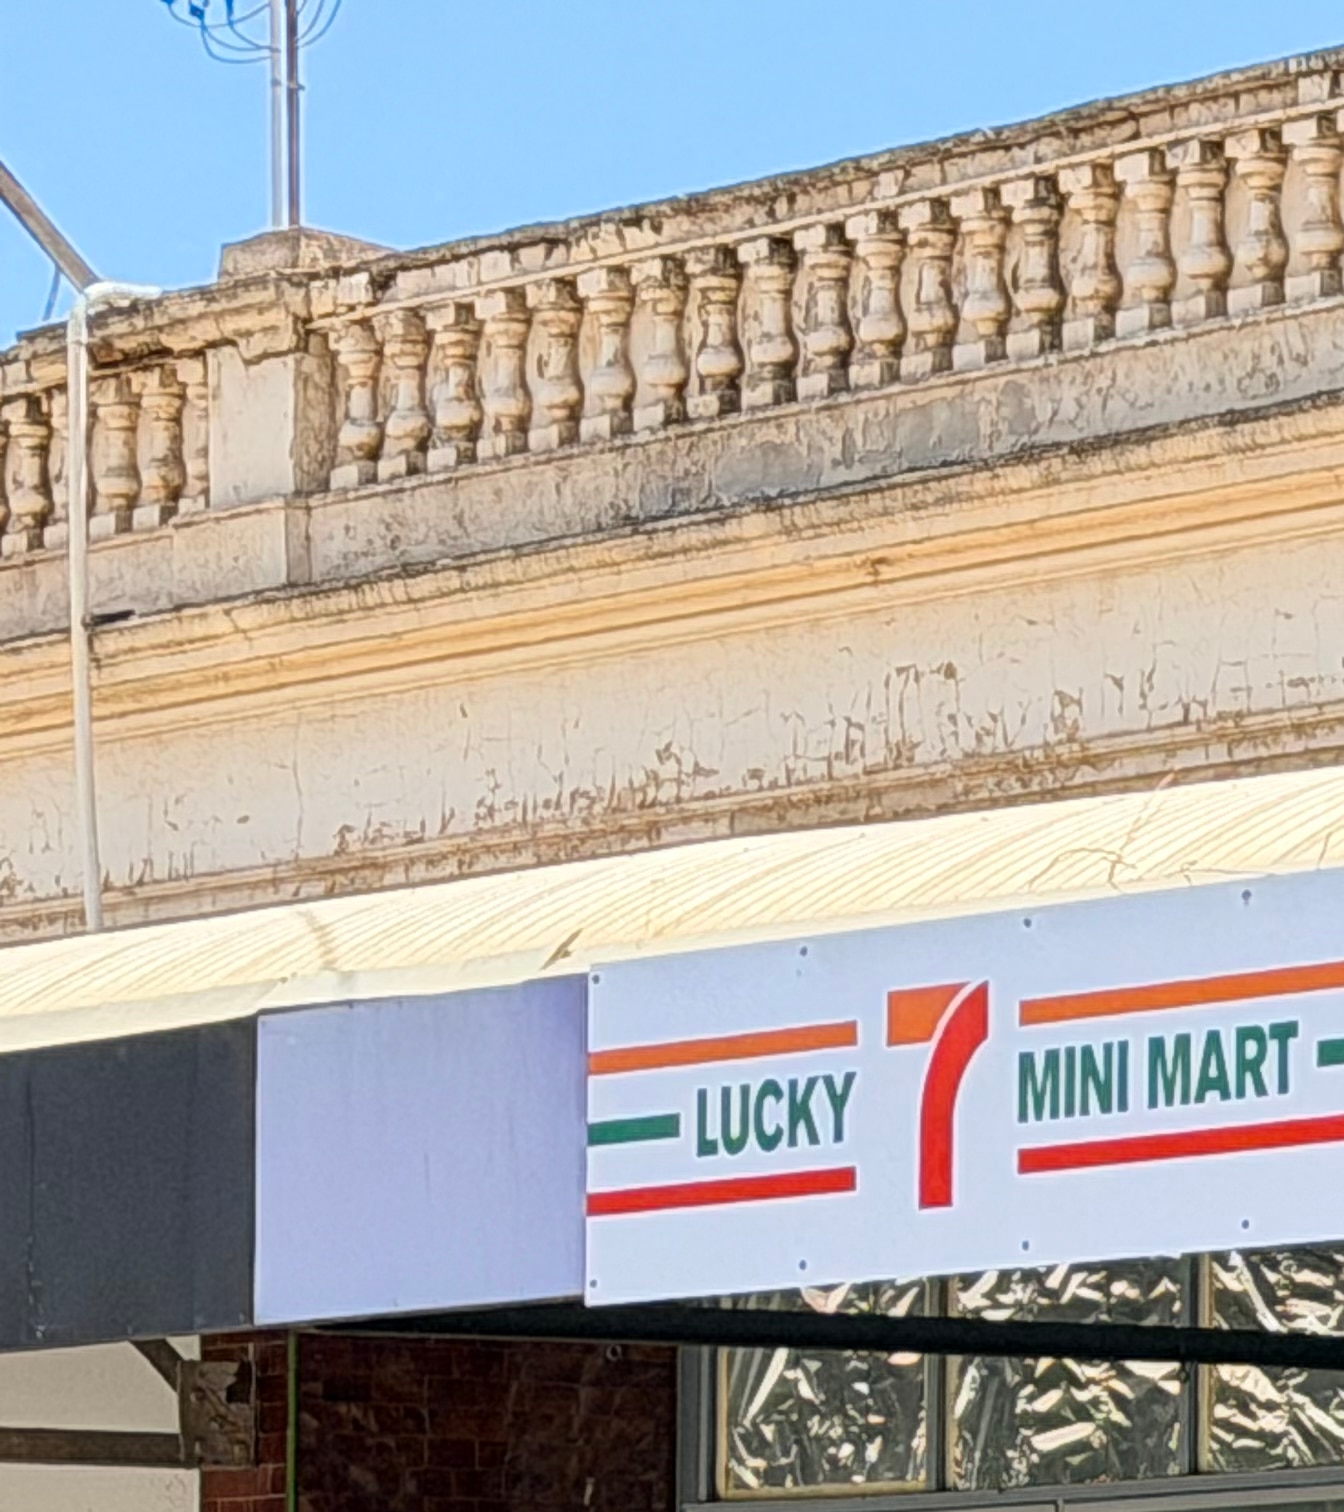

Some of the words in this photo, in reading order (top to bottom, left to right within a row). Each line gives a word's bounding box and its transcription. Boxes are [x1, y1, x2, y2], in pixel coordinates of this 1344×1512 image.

[697, 1071, 857, 1158] LUCKY
[887, 980, 989, 1210] 7
[1017, 1040, 1128, 1123] MINI
[1147, 1021, 1299, 1107] MART
